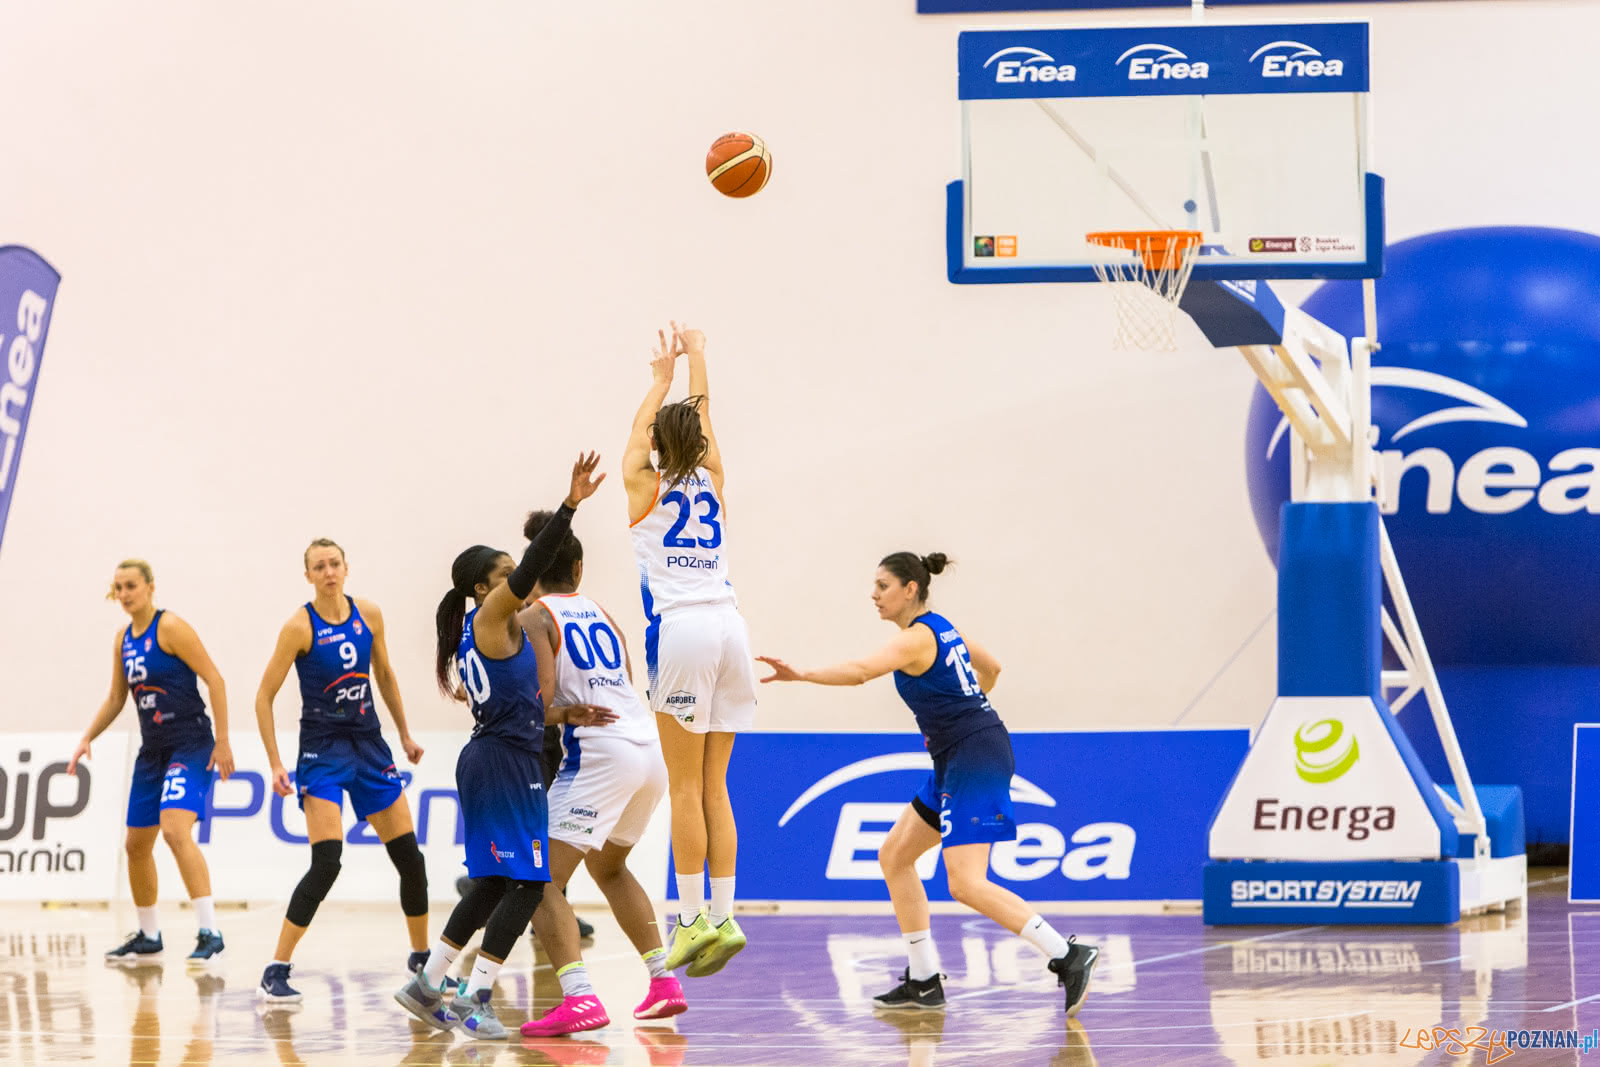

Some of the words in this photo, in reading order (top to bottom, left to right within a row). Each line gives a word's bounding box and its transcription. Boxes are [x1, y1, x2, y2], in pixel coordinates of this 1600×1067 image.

[995, 61, 1076, 83] Enea
[1128, 58, 1209, 80] Enea
[1261, 55, 1344, 78] Enea
[1376, 446, 1600, 514] nea
[661, 490, 722, 549] 23
[339, 641, 358, 670] 9
[564, 622, 622, 670] 00
[126, 656, 148, 684] 25
[946, 643, 981, 697] 15
[666, 695, 697, 705] AGROBEX
[0, 751, 91, 841] jp
[1253, 798, 1396, 841] Energa
